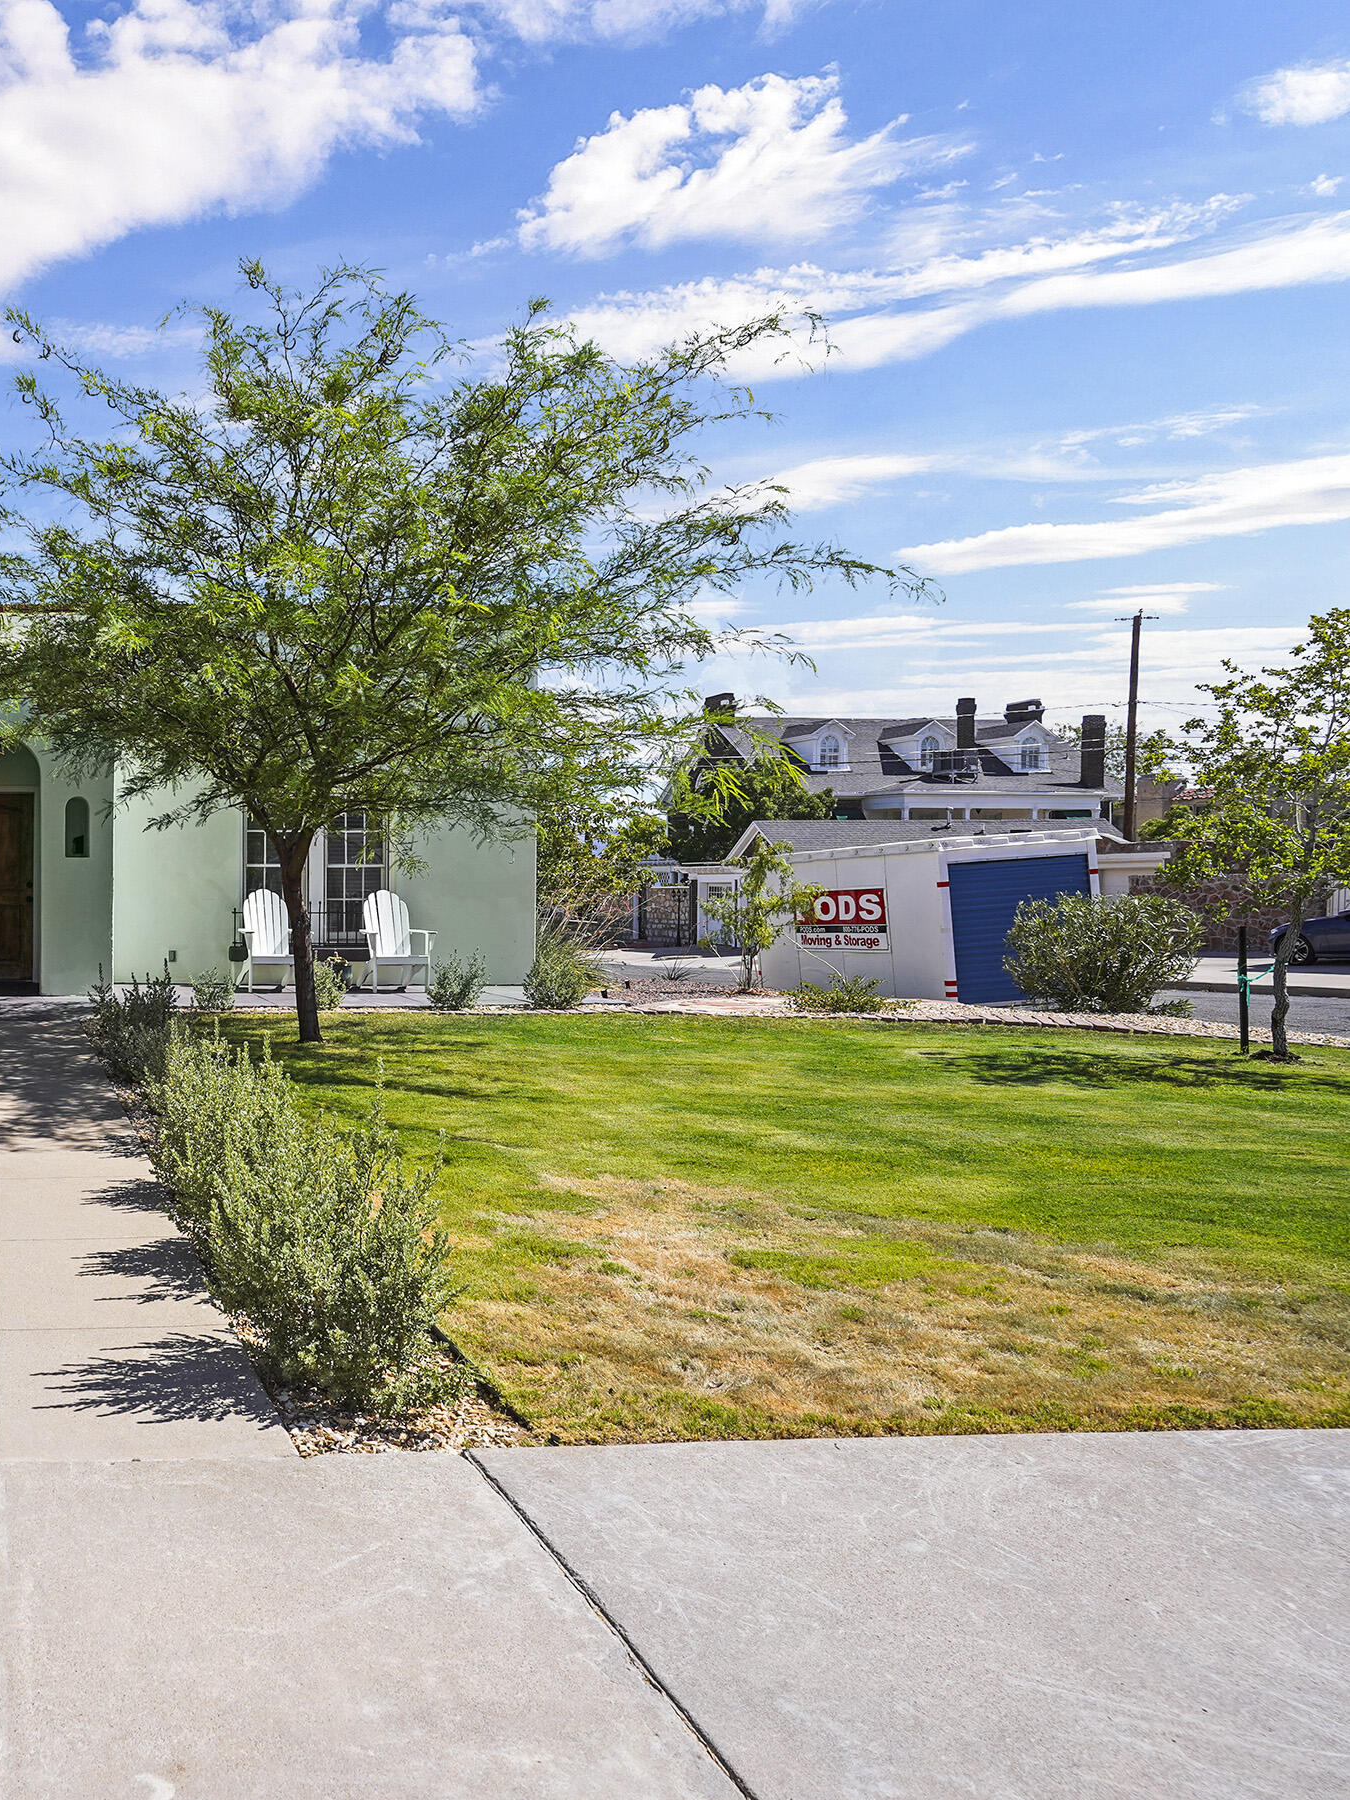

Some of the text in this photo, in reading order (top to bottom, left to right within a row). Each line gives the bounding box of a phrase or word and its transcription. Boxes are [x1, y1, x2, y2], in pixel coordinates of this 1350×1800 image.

[800, 934, 880, 949] Moving & Storage
